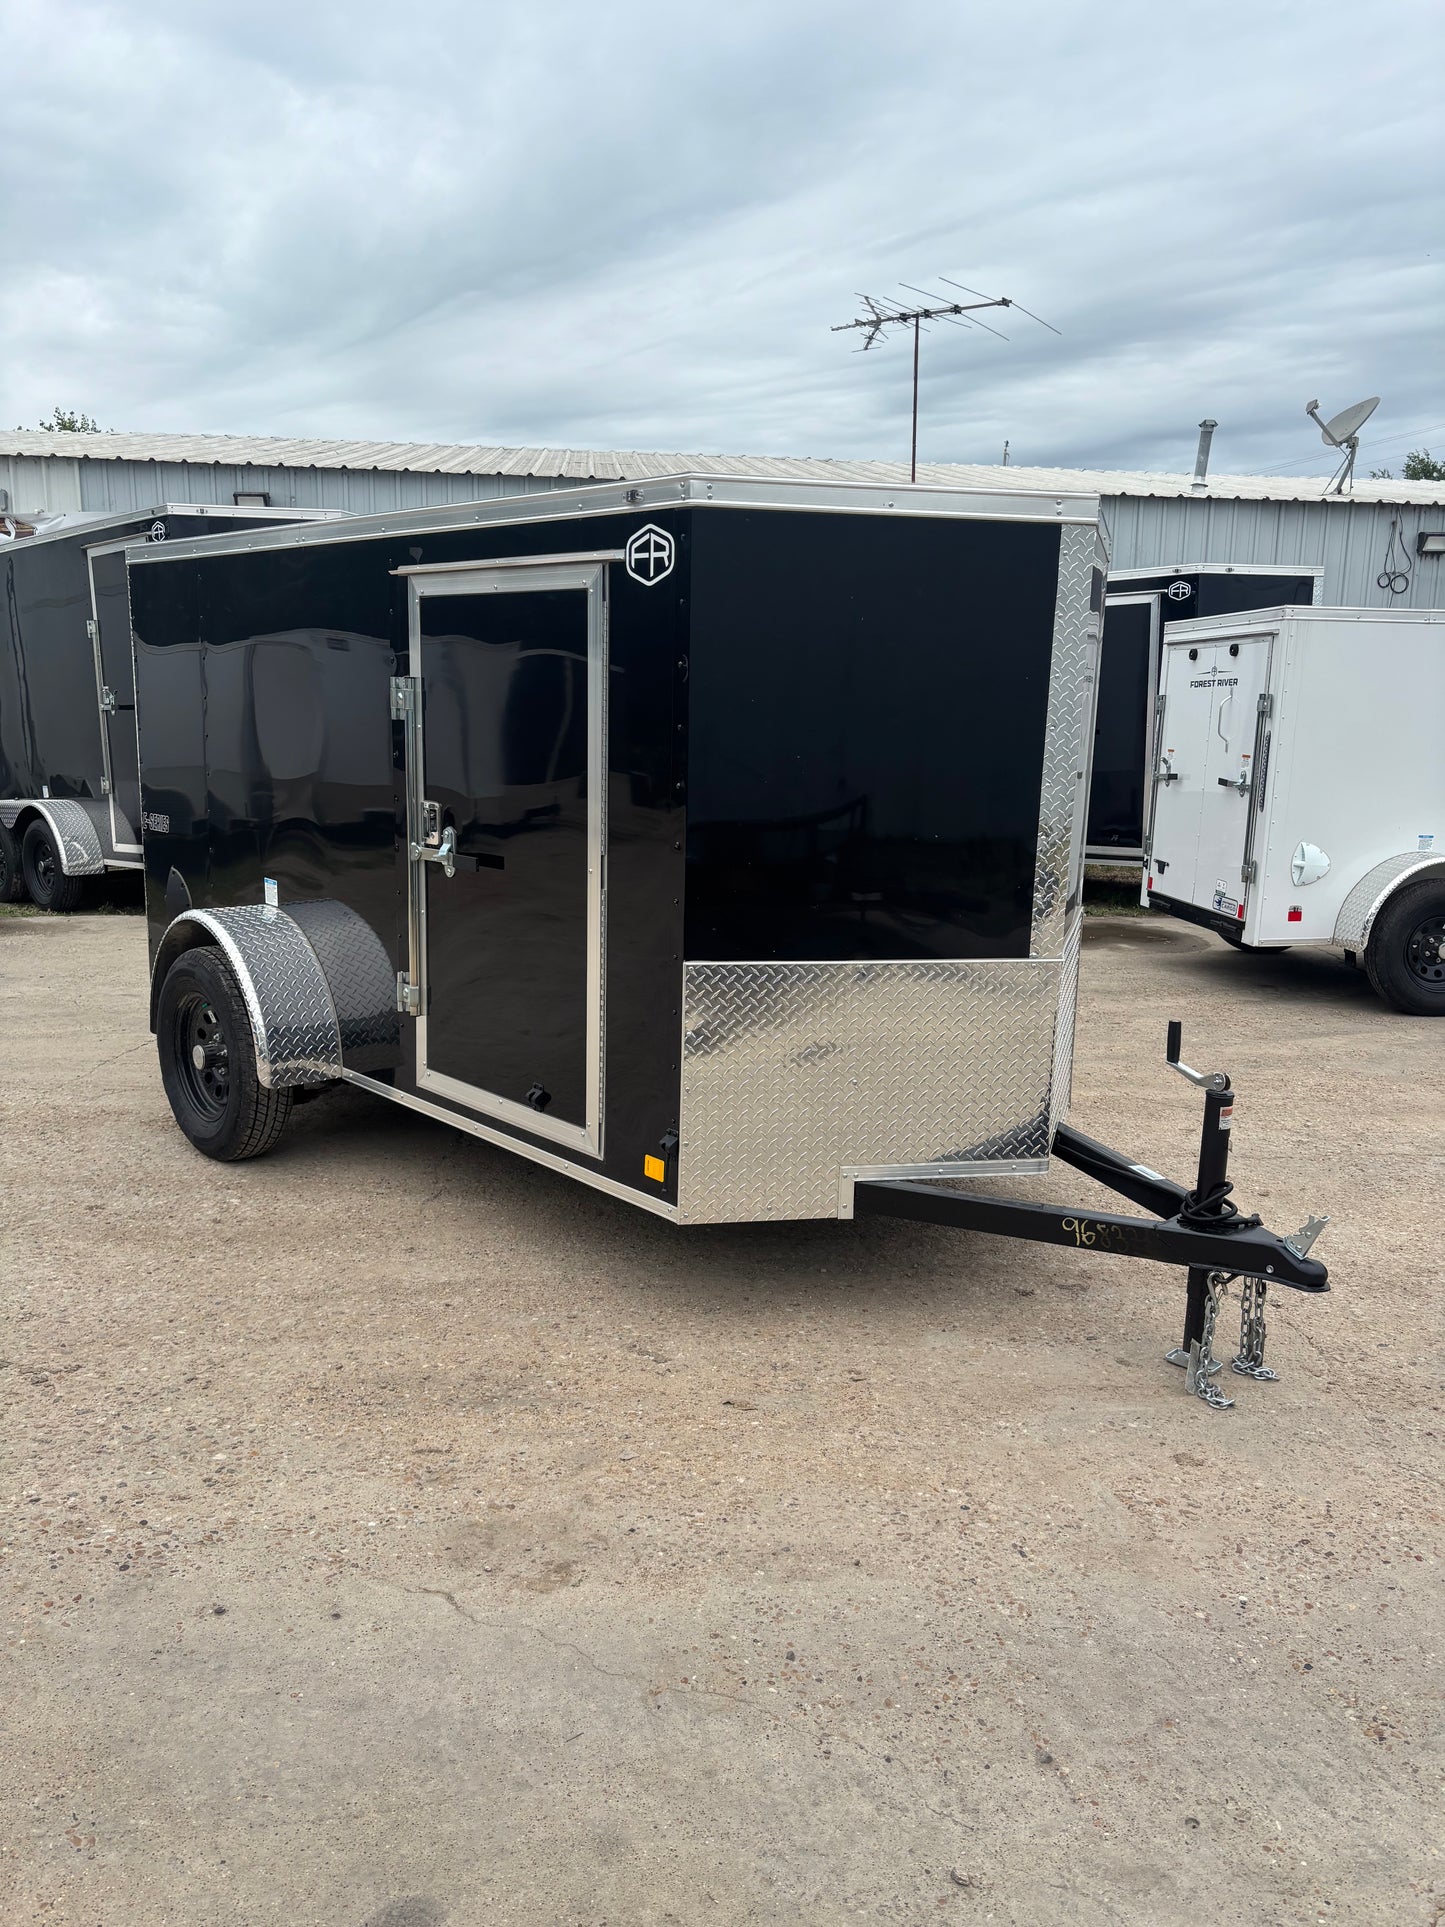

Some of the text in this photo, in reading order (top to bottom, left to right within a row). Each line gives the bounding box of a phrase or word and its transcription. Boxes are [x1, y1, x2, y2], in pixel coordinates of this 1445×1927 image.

[630, 531, 670, 578] FR
[1190, 678, 1238, 688] FOREST RIVER
